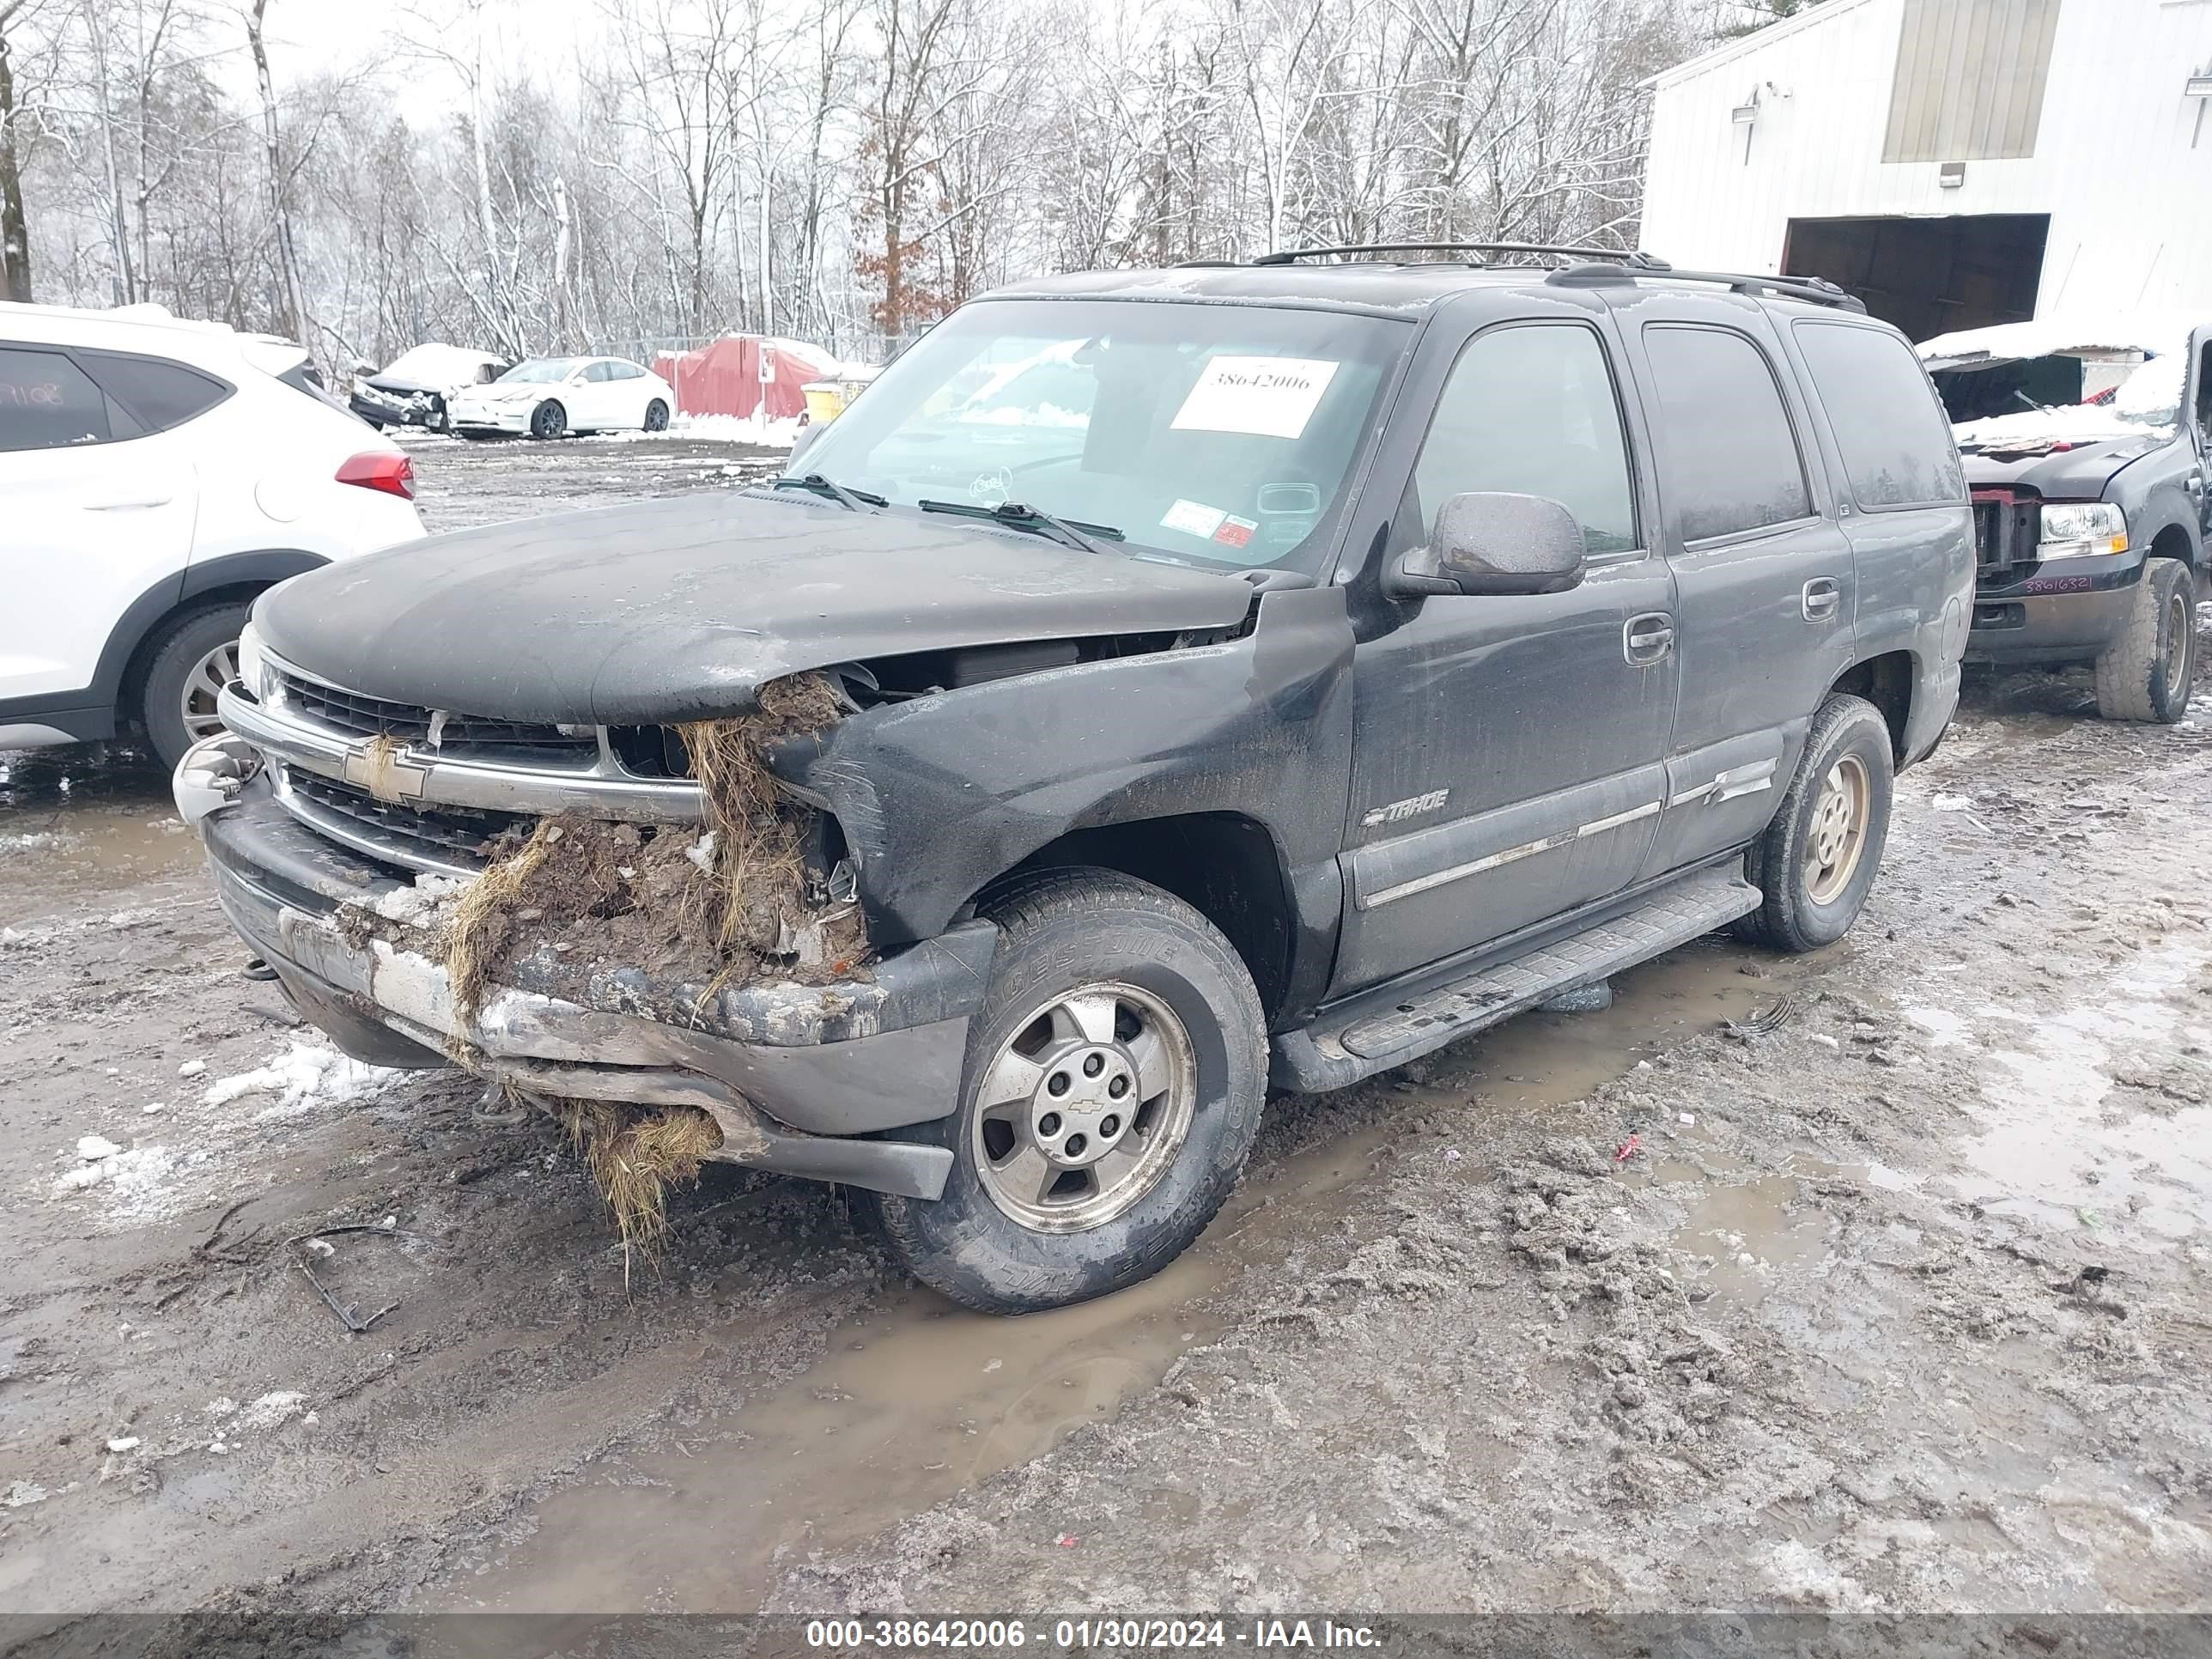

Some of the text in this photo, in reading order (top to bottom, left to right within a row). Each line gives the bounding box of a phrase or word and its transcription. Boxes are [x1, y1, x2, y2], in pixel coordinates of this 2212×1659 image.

[1210, 373, 1310, 390] 38642006
[2026, 576, 2093, 592] 38616321
[1388, 788, 1449, 822] TAHOE
